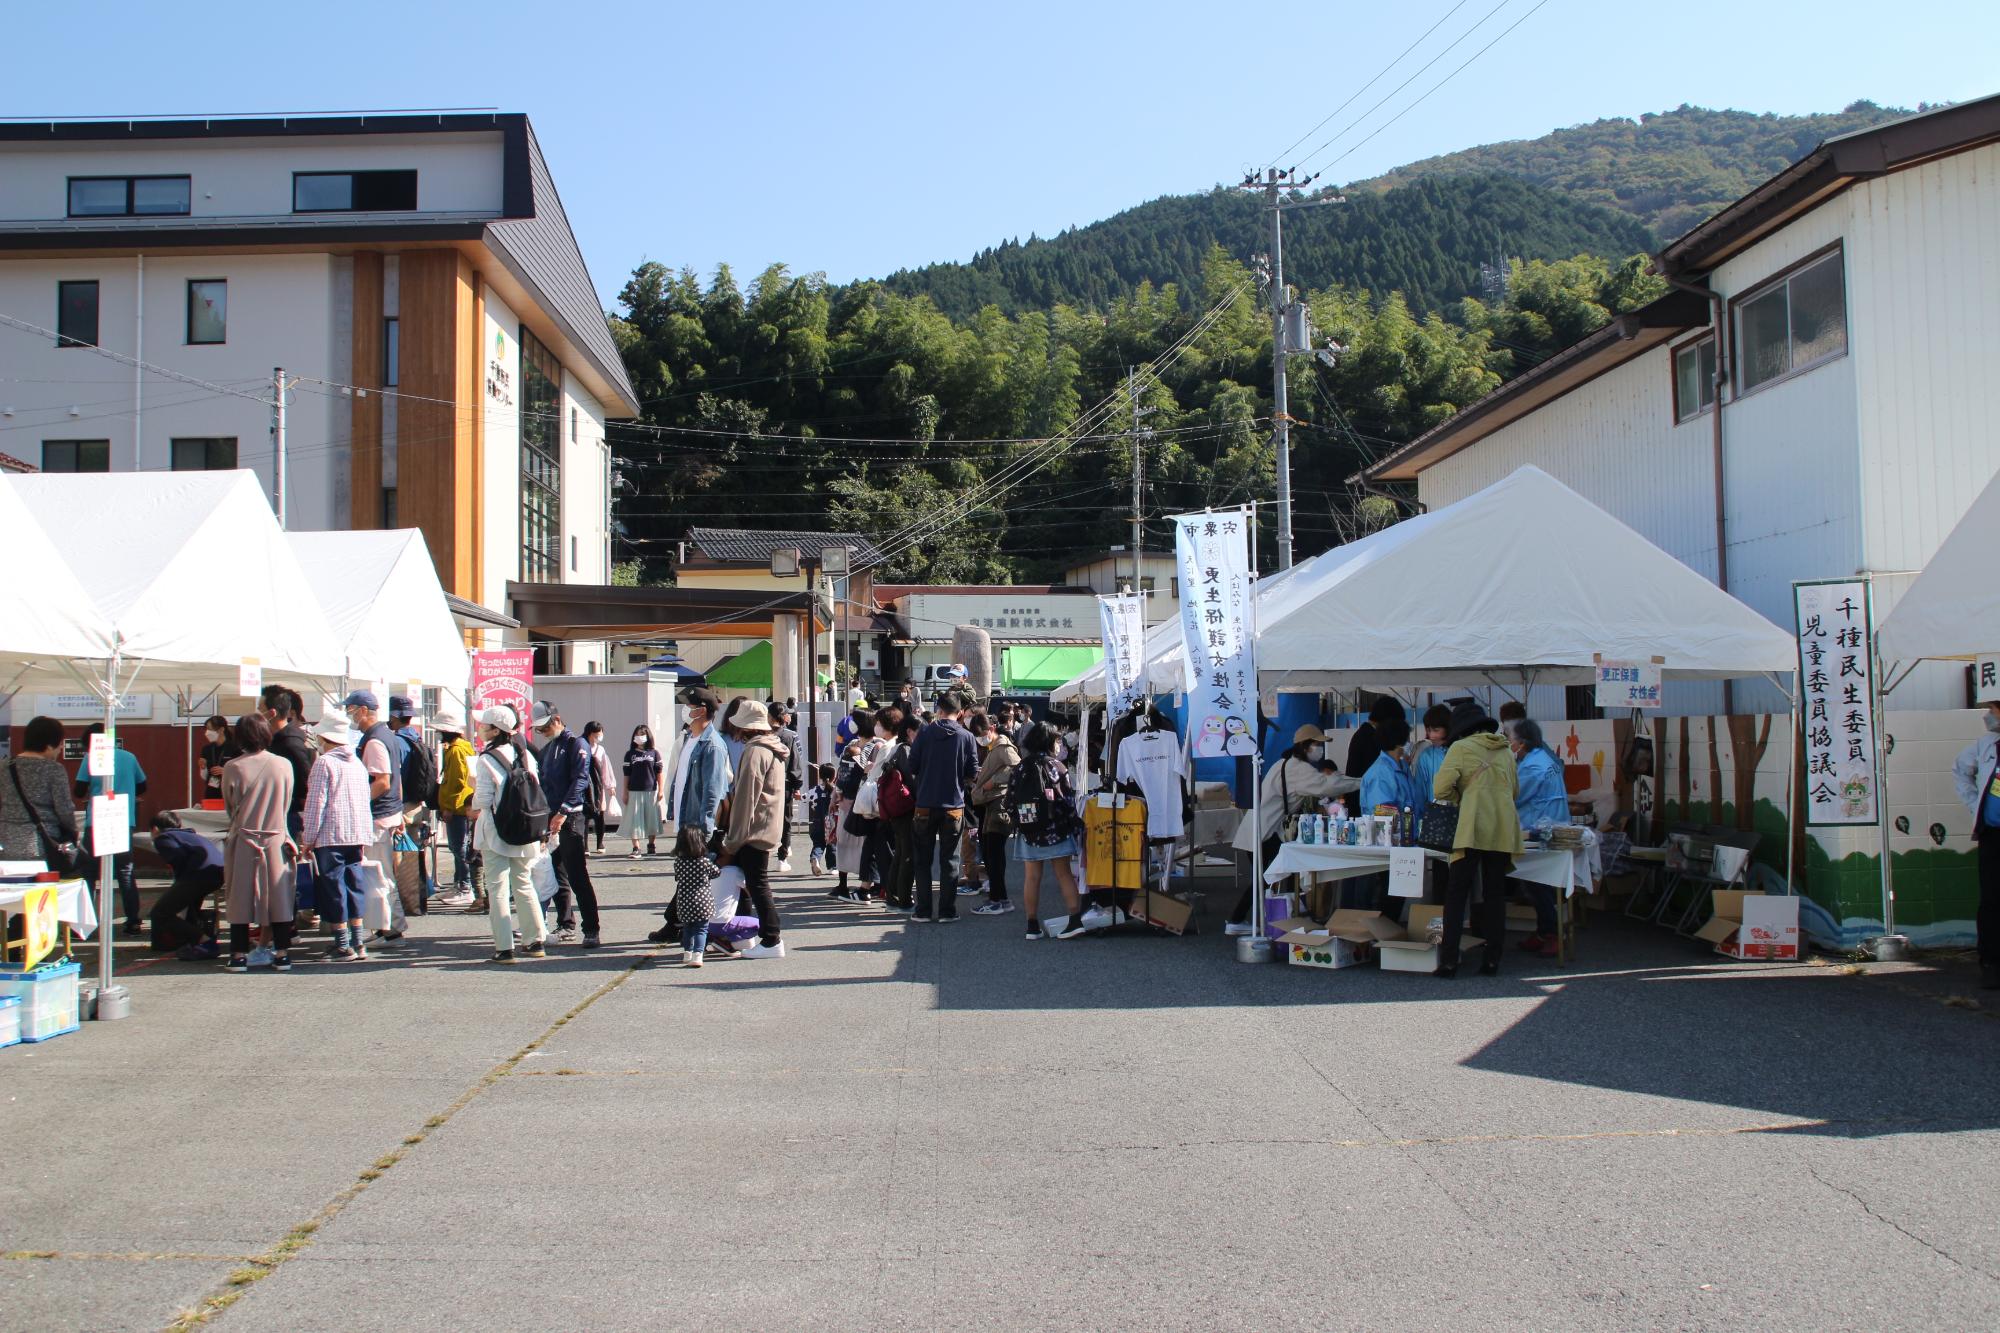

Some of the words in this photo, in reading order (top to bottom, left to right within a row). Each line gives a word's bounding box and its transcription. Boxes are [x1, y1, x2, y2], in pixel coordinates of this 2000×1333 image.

[480, 679, 528, 694] ご協力ください
[1629, 685, 1657, 699] 女性会
[1802, 613, 1837, 803] 児童委員協議会
[1836, 597, 1867, 763] 千種民生委員
